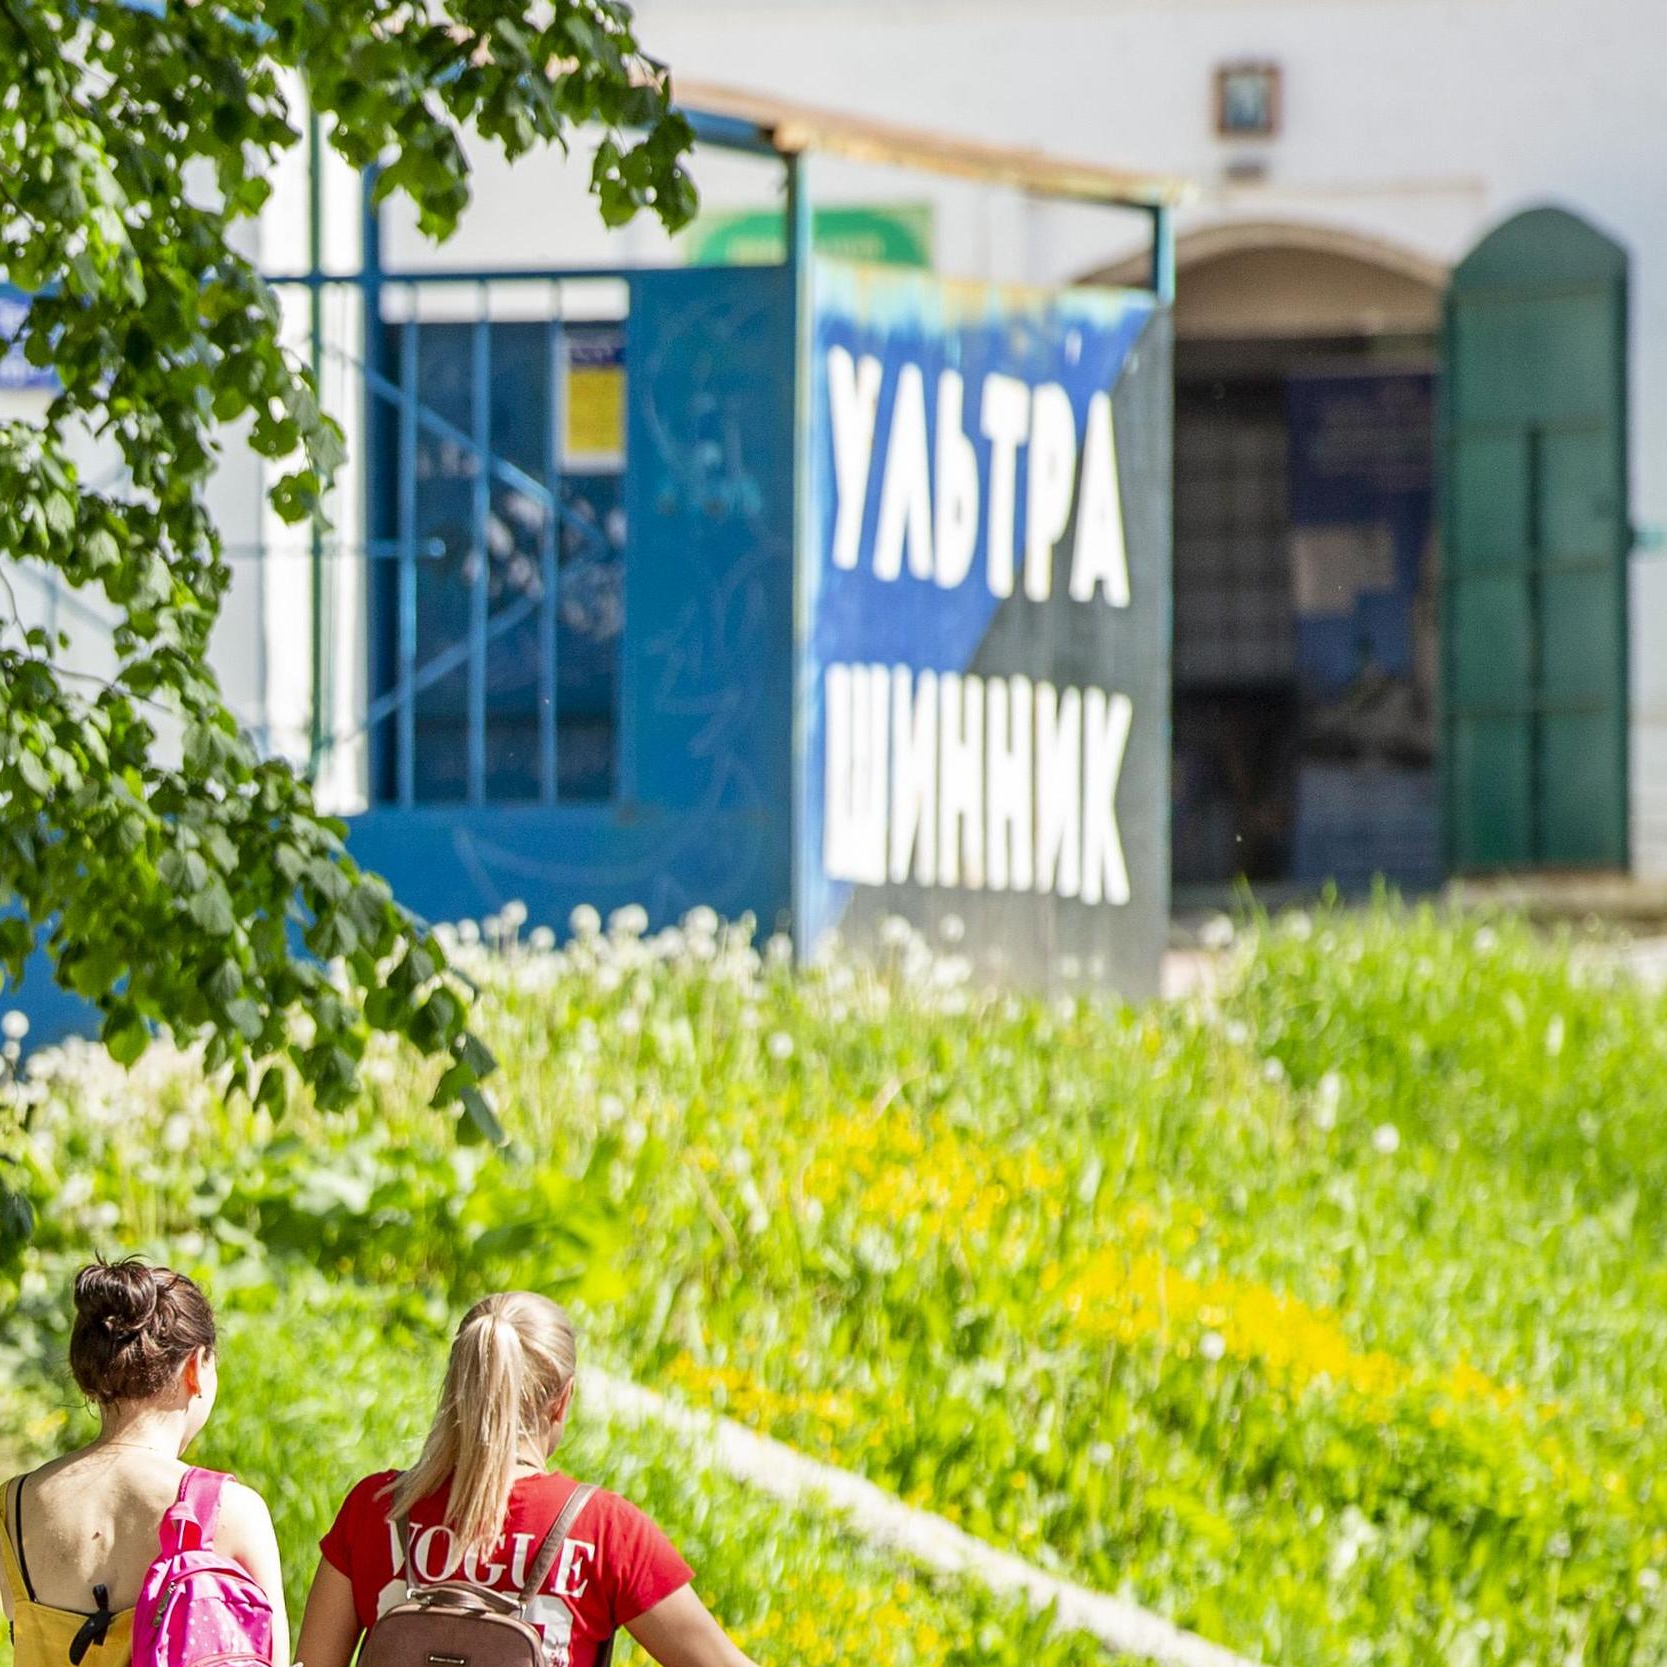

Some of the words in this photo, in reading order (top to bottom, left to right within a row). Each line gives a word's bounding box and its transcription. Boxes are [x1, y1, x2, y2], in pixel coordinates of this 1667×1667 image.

[827, 343, 1130, 607] УЛЬТРА
[822, 662, 1131, 905] ШИННИК
[387, 1519, 595, 1598] VOGUE
